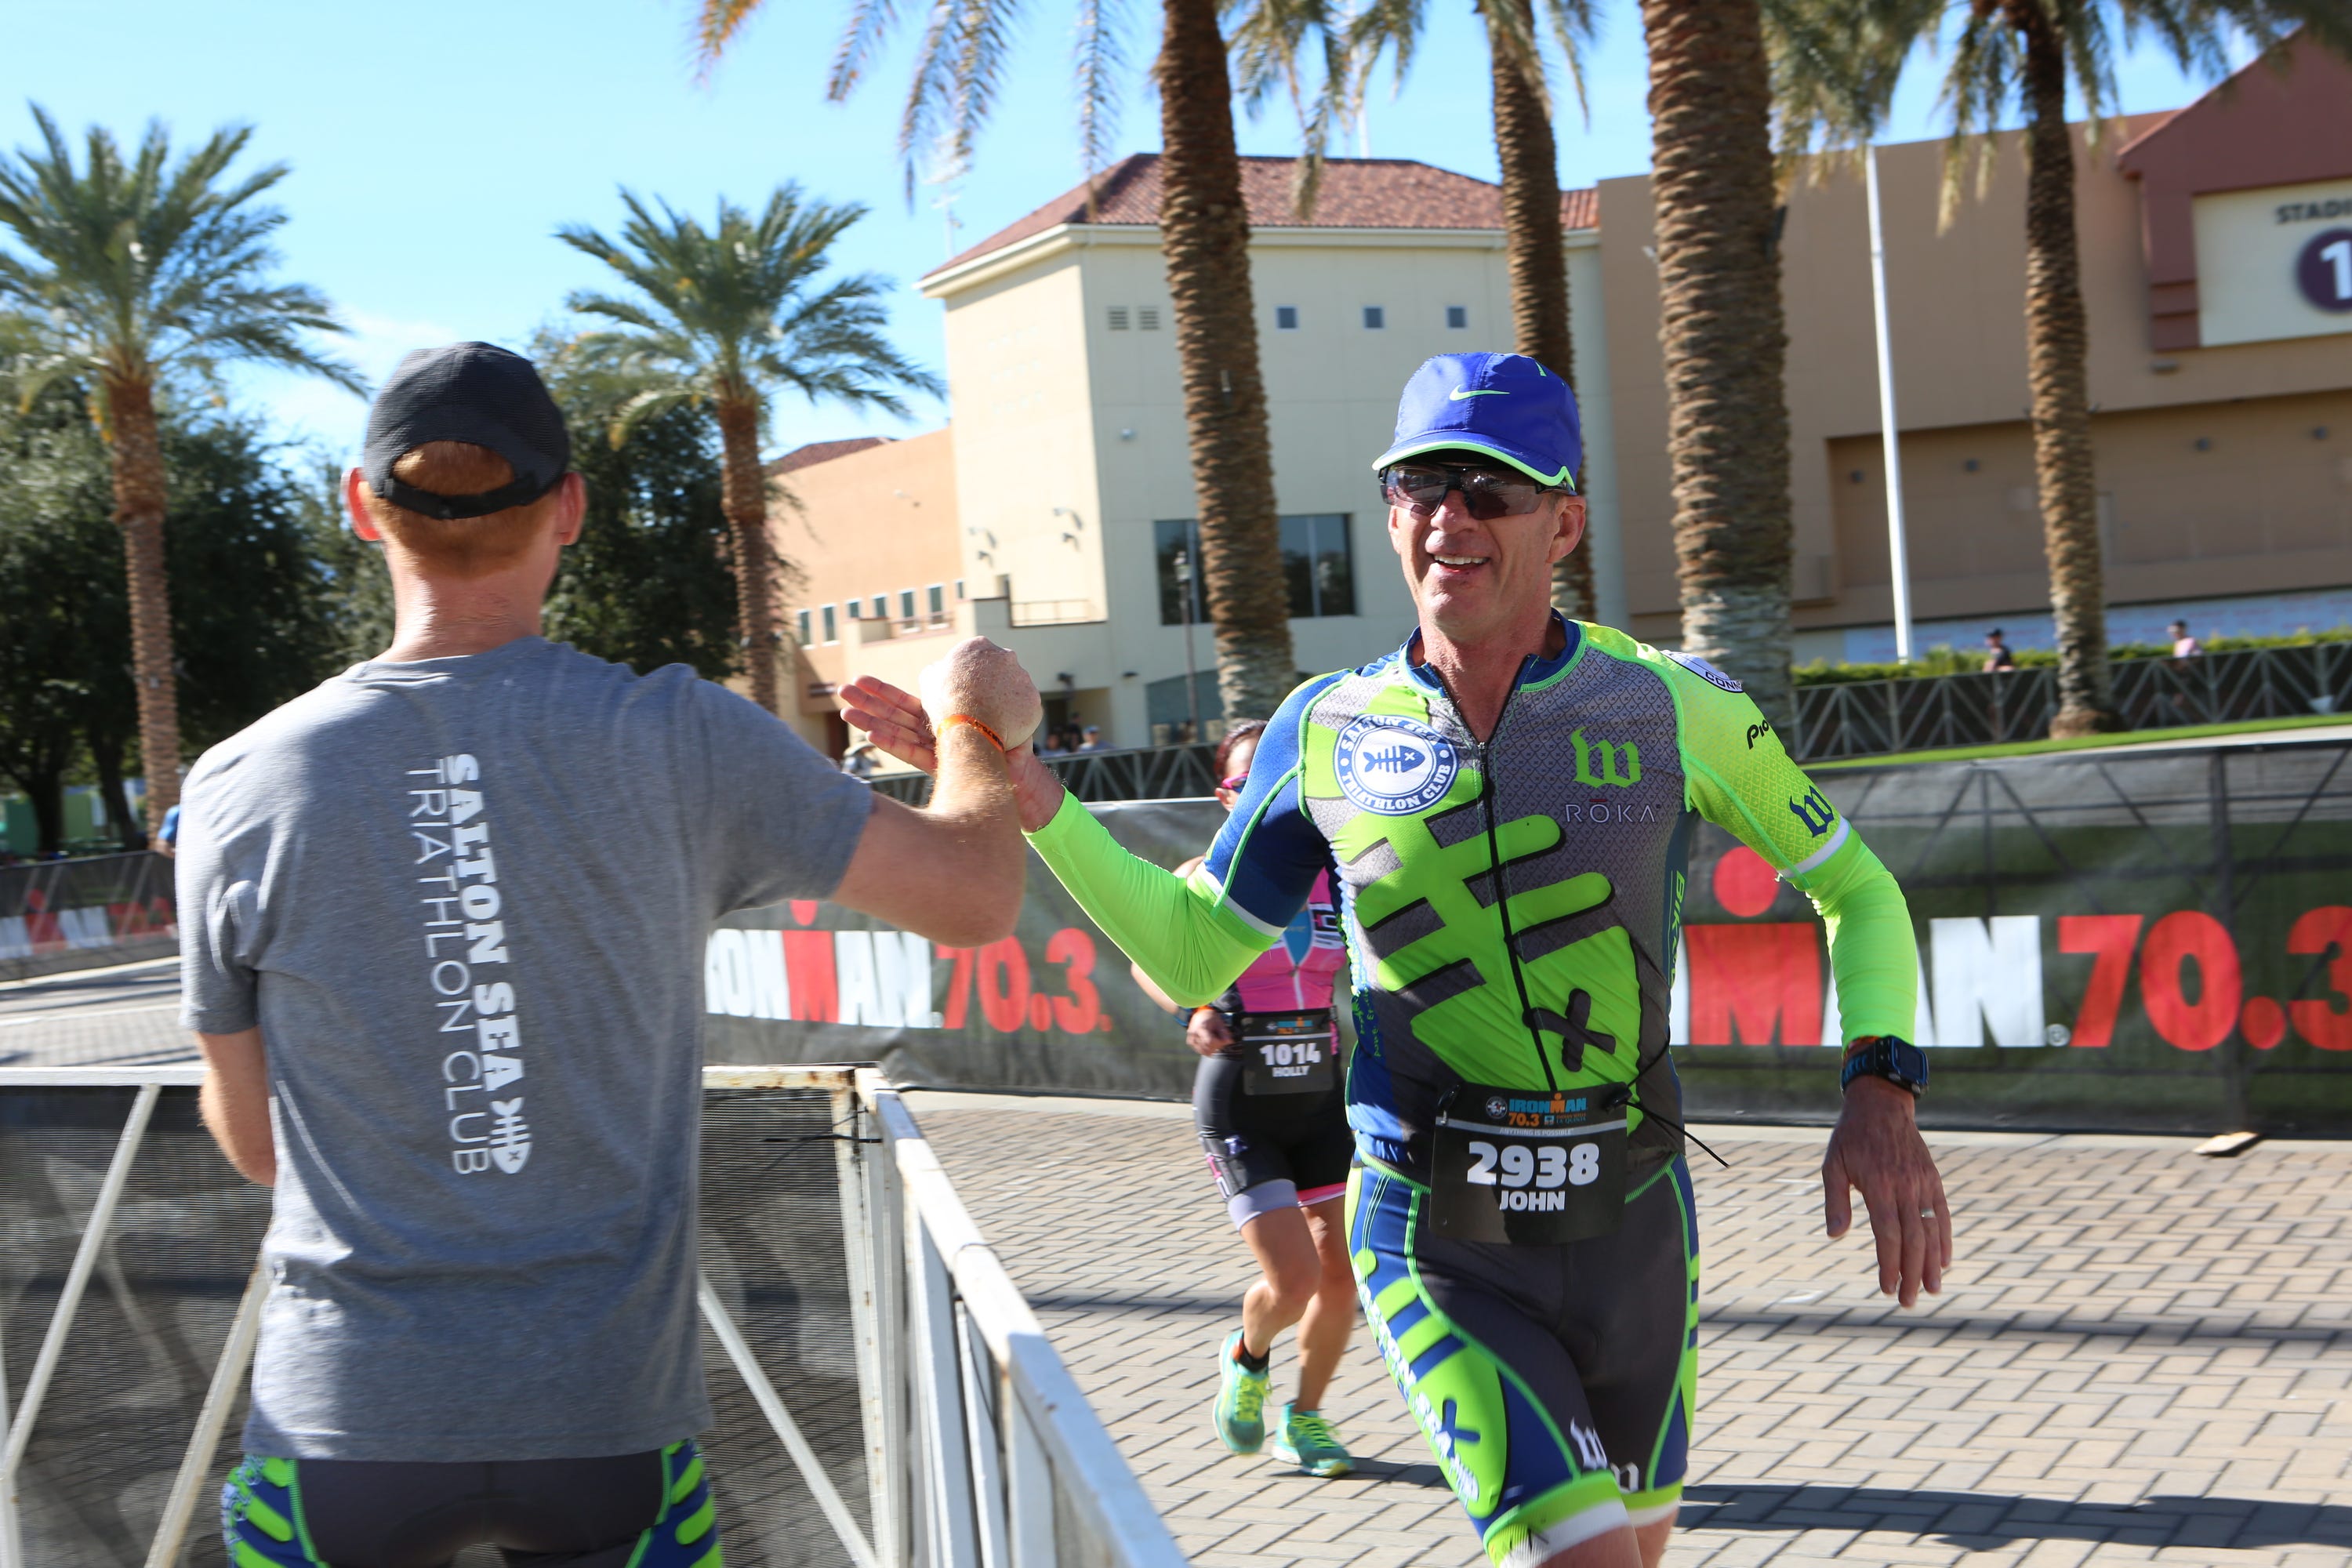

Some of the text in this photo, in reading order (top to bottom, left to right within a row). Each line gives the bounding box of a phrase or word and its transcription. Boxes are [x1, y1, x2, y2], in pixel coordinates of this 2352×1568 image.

[2320, 240, 2352, 299] 1
[1341, 715, 1399, 752] SALTON
[1341, 764, 1451, 811] TRIATHLON CLUB
[446, 753, 525, 1092] SALTON SEA
[405, 757, 492, 1174] TRIATHLON CLUB
[935, 927, 1103, 1034] 70.3
[2056, 905, 2352, 1051] 70.3
[1259, 1042, 1322, 1065] 1014
[1272, 1065, 1310, 1077] HOLLY
[1508, 1112, 1540, 1127] 70.3
[1509, 1093, 1588, 1114] IRONMAN
[1499, 1127, 1534, 1136] ANYTHING
[1467, 1141, 1599, 1189] 2938
[1499, 1190, 1566, 1211] JOHN
